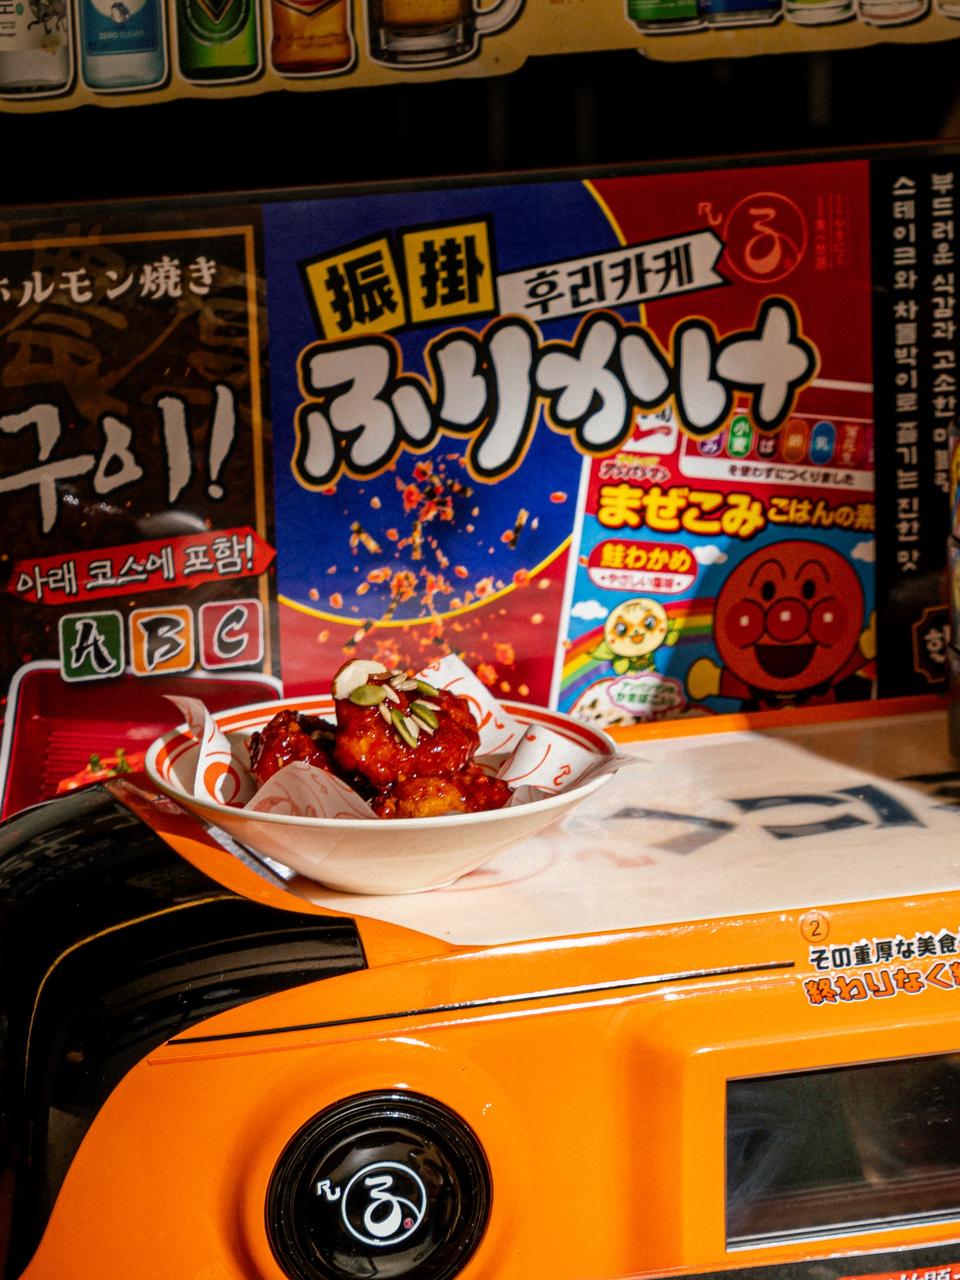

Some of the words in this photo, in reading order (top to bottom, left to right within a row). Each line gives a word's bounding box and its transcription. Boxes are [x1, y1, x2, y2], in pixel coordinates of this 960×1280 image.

[930, 171, 956, 267] 부드러운
[323, 234, 486, 331] 振掛
[524, 241, 696, 313] 후리카케
[931, 272, 957, 341] 식감과
[300, 300, 815, 484] ふりかけ
[931, 350, 958, 419] 고소한
[598, 483, 767, 538] まぜこみ
[16, 559, 78, 601] 아래
[86, 546, 175, 591] 코스에
[183, 533, 255, 578] 포함!
[600, 542, 693, 574] 鮭わかめ
[68, 614, 117, 674] A
[138, 611, 188, 671] B
